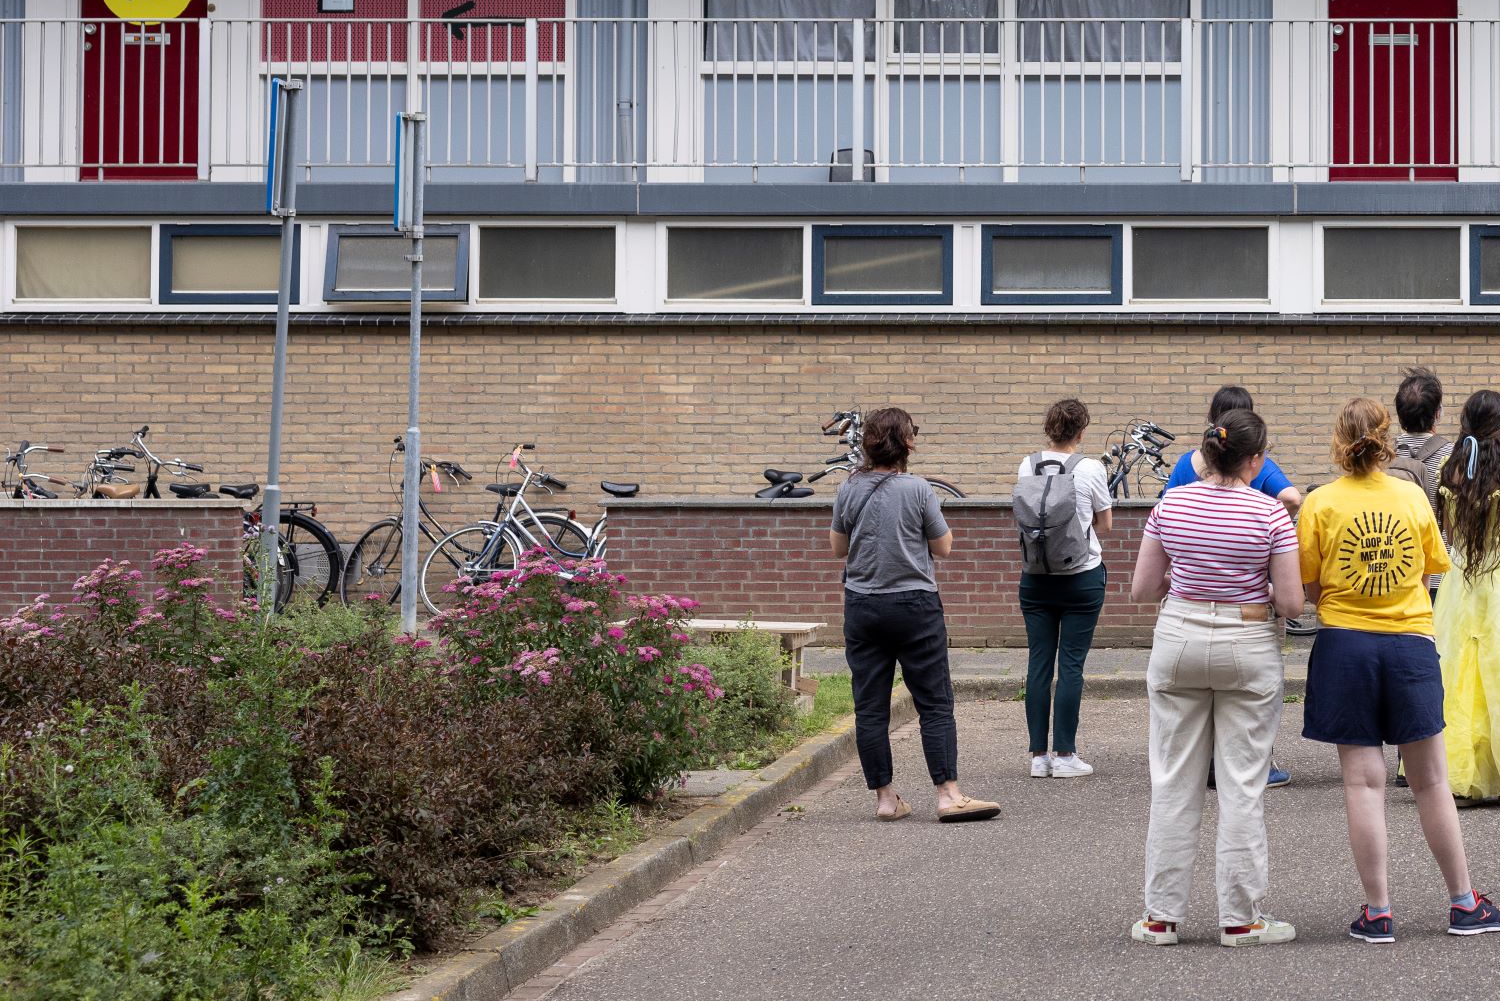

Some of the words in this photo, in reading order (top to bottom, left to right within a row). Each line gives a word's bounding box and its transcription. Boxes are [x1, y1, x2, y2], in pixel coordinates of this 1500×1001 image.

[1361, 537, 1382, 549] LOOP
[1384, 535, 1393, 546] JE
[1361, 550, 1378, 562] MET
[1380, 548, 1395, 560] MIJ
[1367, 562, 1388, 574] MEE?
